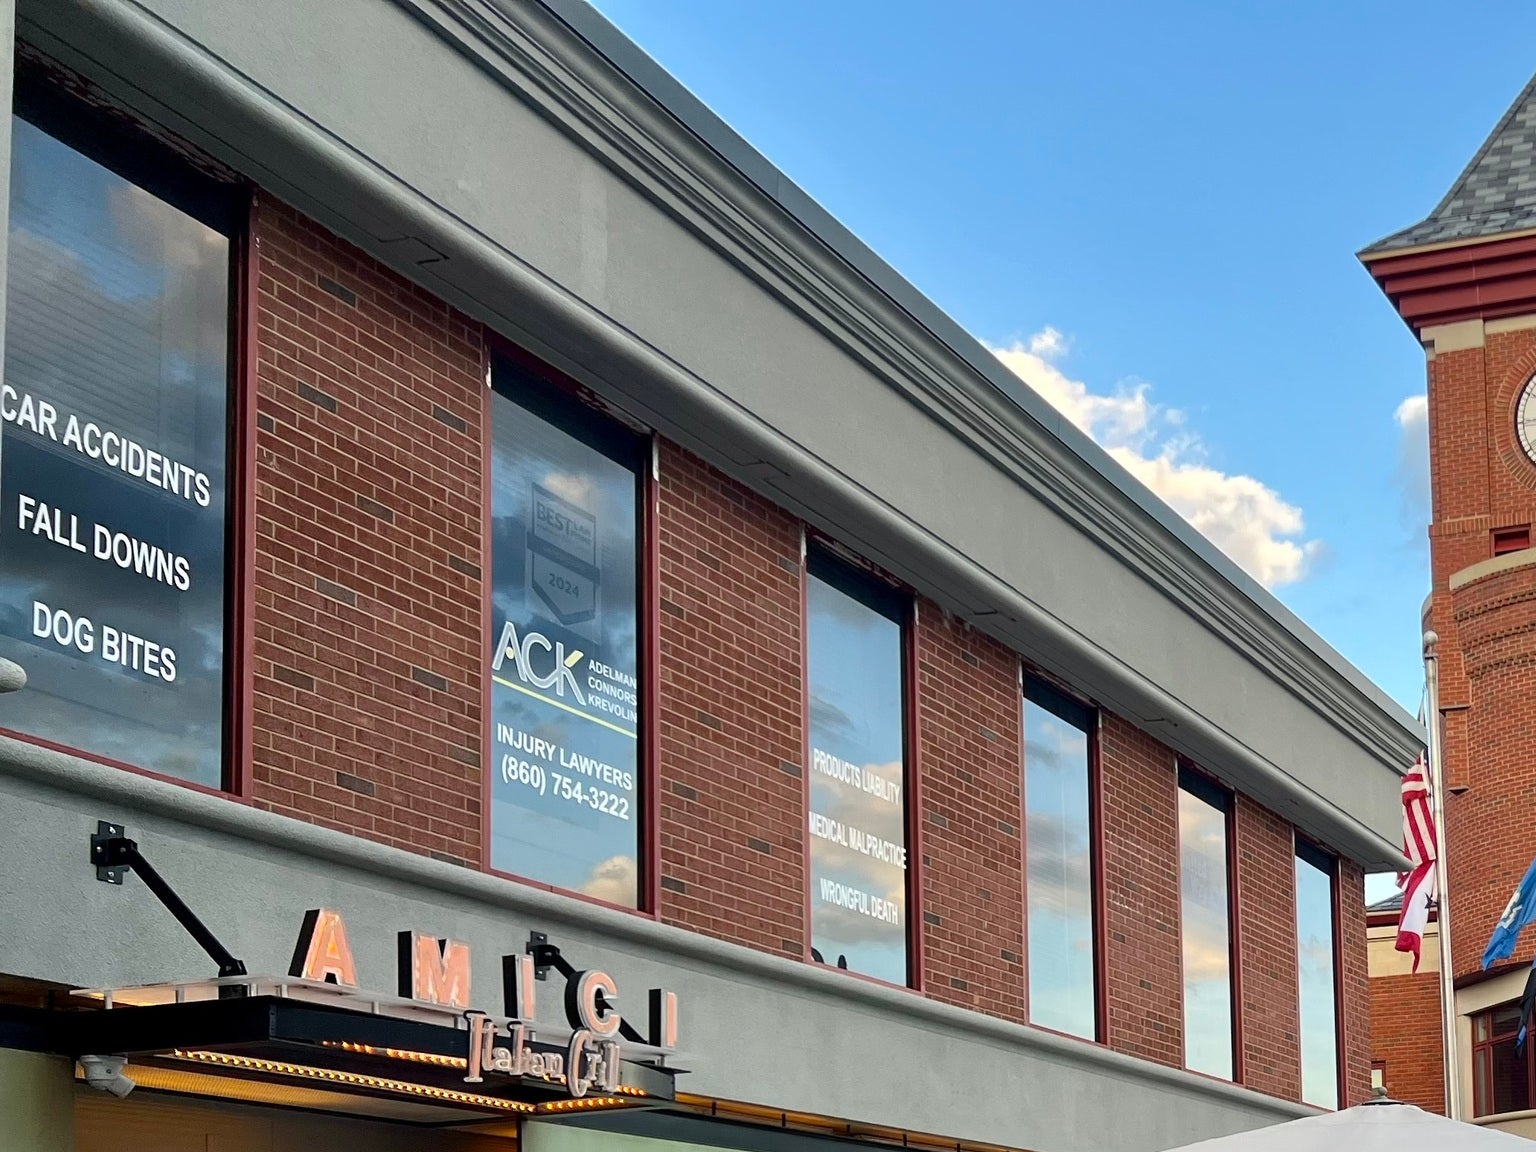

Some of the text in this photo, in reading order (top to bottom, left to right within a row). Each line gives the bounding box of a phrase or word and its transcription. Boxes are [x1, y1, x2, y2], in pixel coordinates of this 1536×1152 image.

[1, 384, 211, 507] CAR ACCIDENTS
[18, 493, 191, 592] FALL DOWNS
[549, 572, 580, 598] 2024
[33, 600, 177, 683] DOG BITES
[491, 620, 587, 706] ACK
[588, 659, 637, 690] ADELMAN
[588, 676, 637, 707] CONNORS
[588, 693, 637, 724] KREVOLIN
[497, 722, 633, 791] INJURY LAWYERS
[502, 753, 630, 820] (860) 754-3222
[813, 747, 902, 806] PRODUCTS LIABILITY
[808, 810, 907, 870] MEDICAL MALPRACTICE
[820, 877, 898, 925] WRONGFUL DEATH
[289, 908, 678, 1047] AMICI
[463, 1011, 564, 1083] Italian
